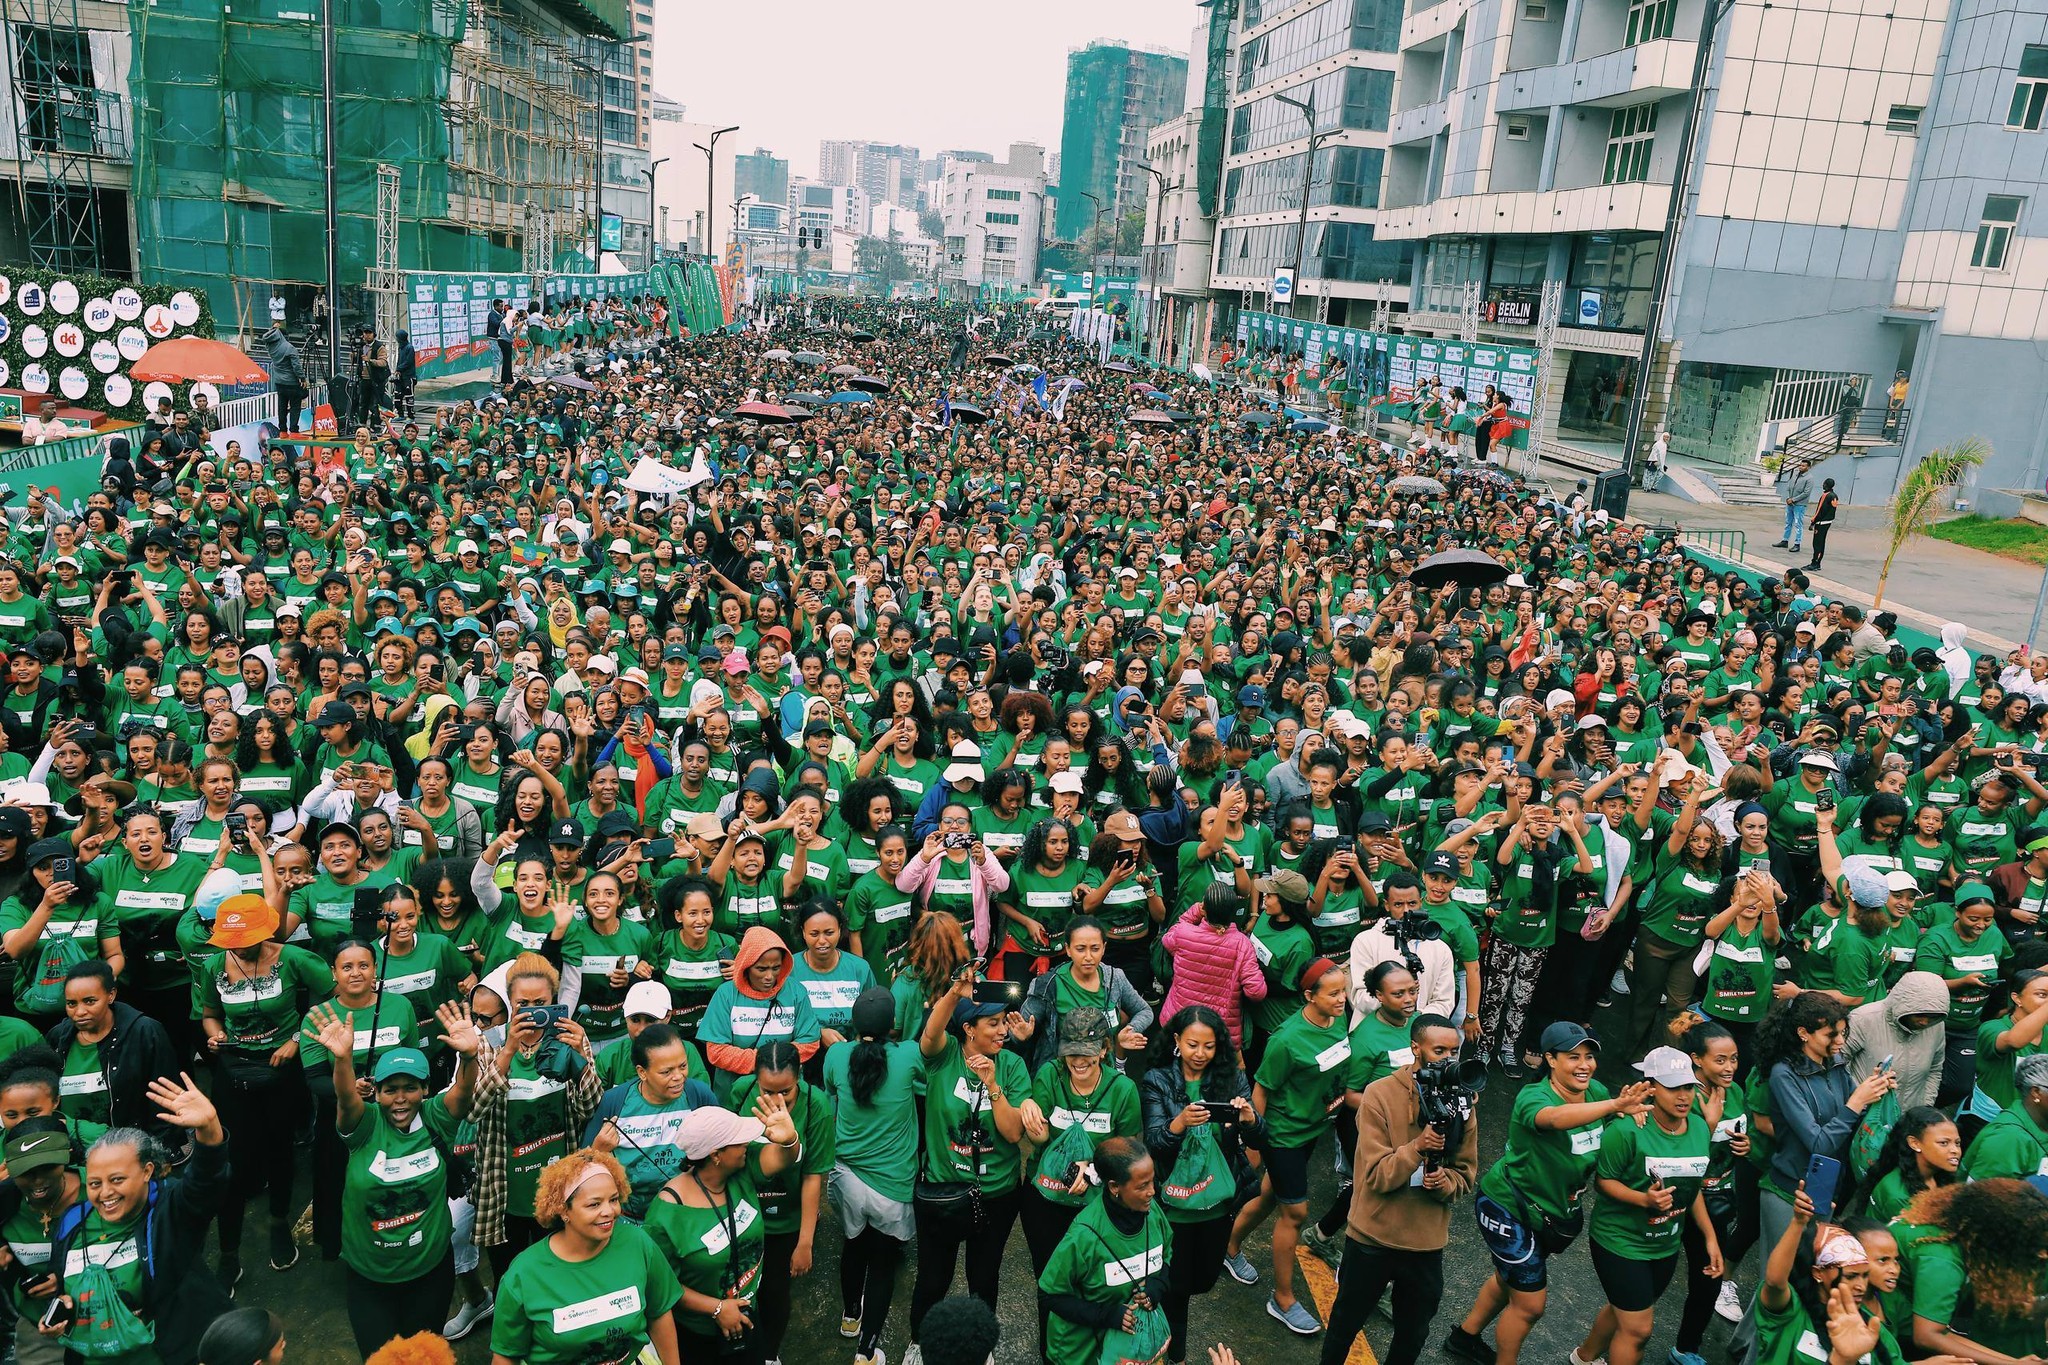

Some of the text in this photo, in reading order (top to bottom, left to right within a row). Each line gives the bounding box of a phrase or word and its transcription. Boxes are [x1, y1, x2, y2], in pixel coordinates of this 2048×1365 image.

[118, 296, 138, 306] TOP
[91, 309, 110, 321] Fab
[1498, 302, 1531, 317] BERLIN
[60, 333, 77, 345] dkt
[382, 975, 432, 990] afaricom WOMEN
[836, 986, 860, 994] WOMEN
[739, 1015, 768, 1023] Safarico
[1670, 1058, 1687, 1069] NY
[622, 1125, 662, 1135] Safaricom
[518, 1139, 543, 1156] SMILE
[408, 1156, 430, 1166] WOMEN
[955, 1162, 971, 1171] pesa
[524, 1162, 542, 1173] pesa
[377, 1217, 405, 1230] SMILE
[406, 1213, 415, 1222] TO
[1480, 1215, 1512, 1237] UFC
[15, 1249, 50, 1257] Safaricom
[1148, 1252, 1162, 1262] OMEN
[568, 1294, 632, 1319] Safaricom WOMEN
